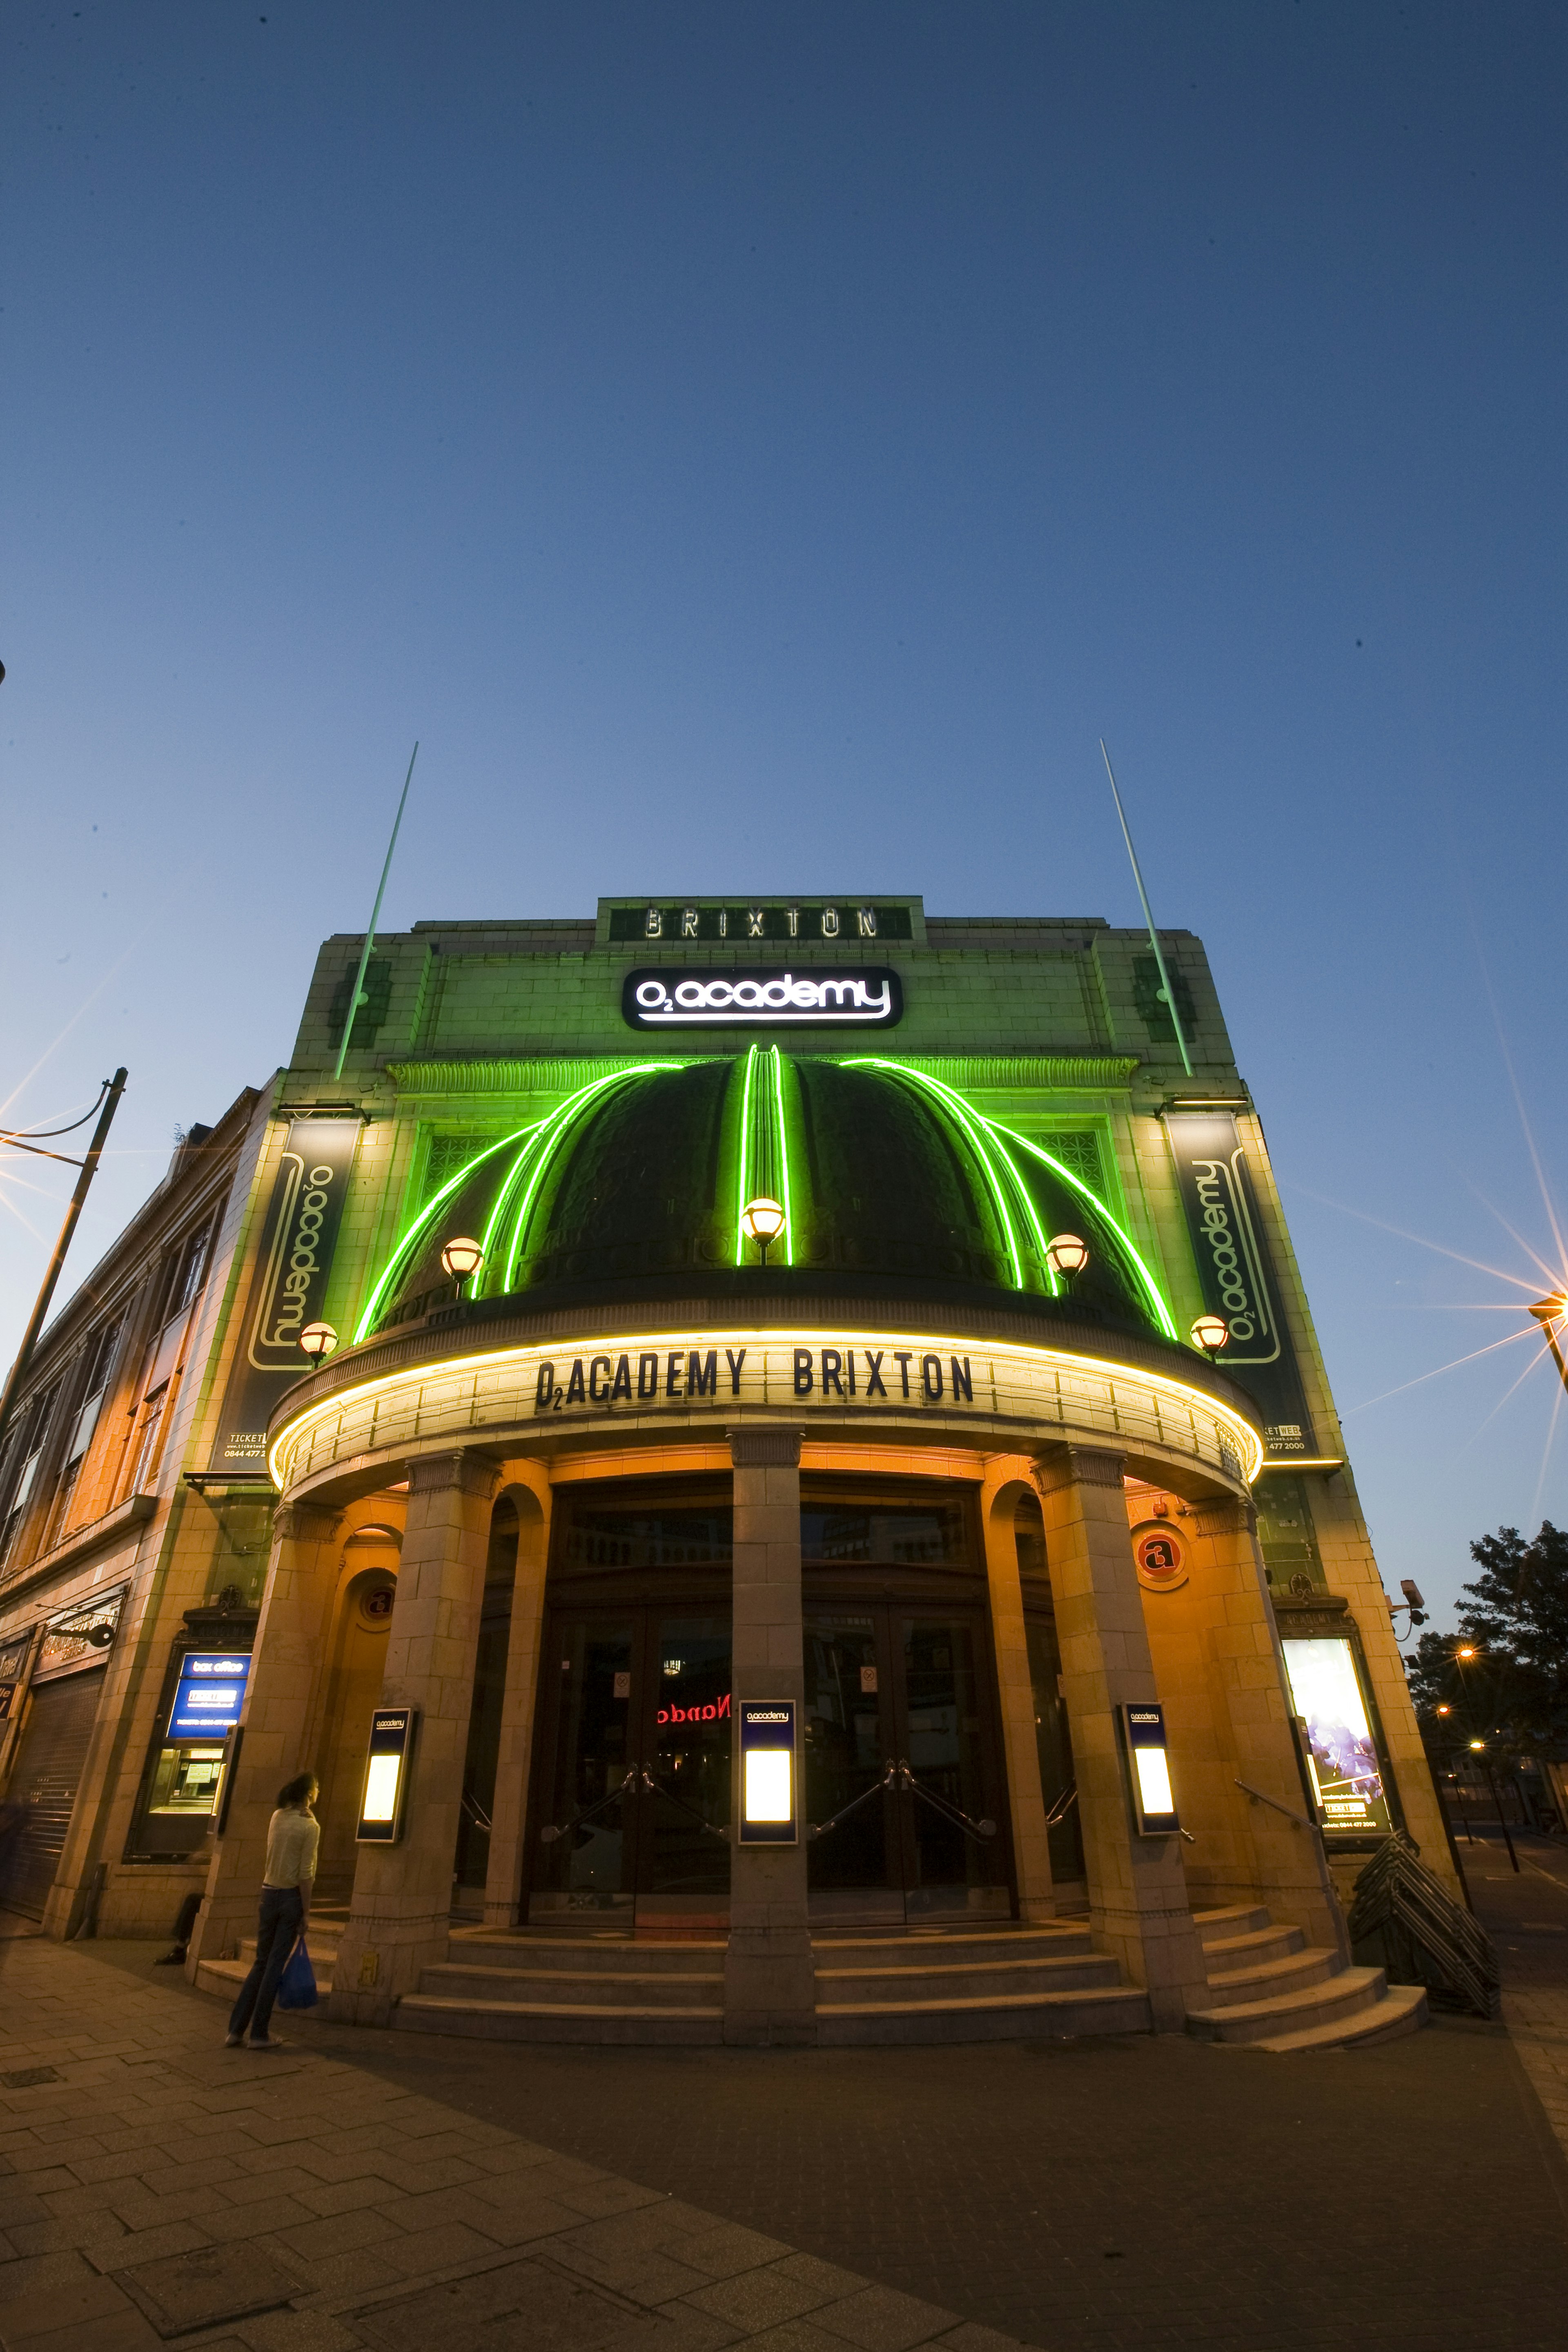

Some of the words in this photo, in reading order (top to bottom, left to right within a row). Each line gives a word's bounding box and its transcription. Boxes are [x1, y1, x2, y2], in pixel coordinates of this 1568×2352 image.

[646, 908, 877, 937] BRIXTON
[794, 1348, 973, 1401] BRIXTON
[1286, 1613, 1331, 1625] ACADEMY
[193, 1661, 213, 1672] box
